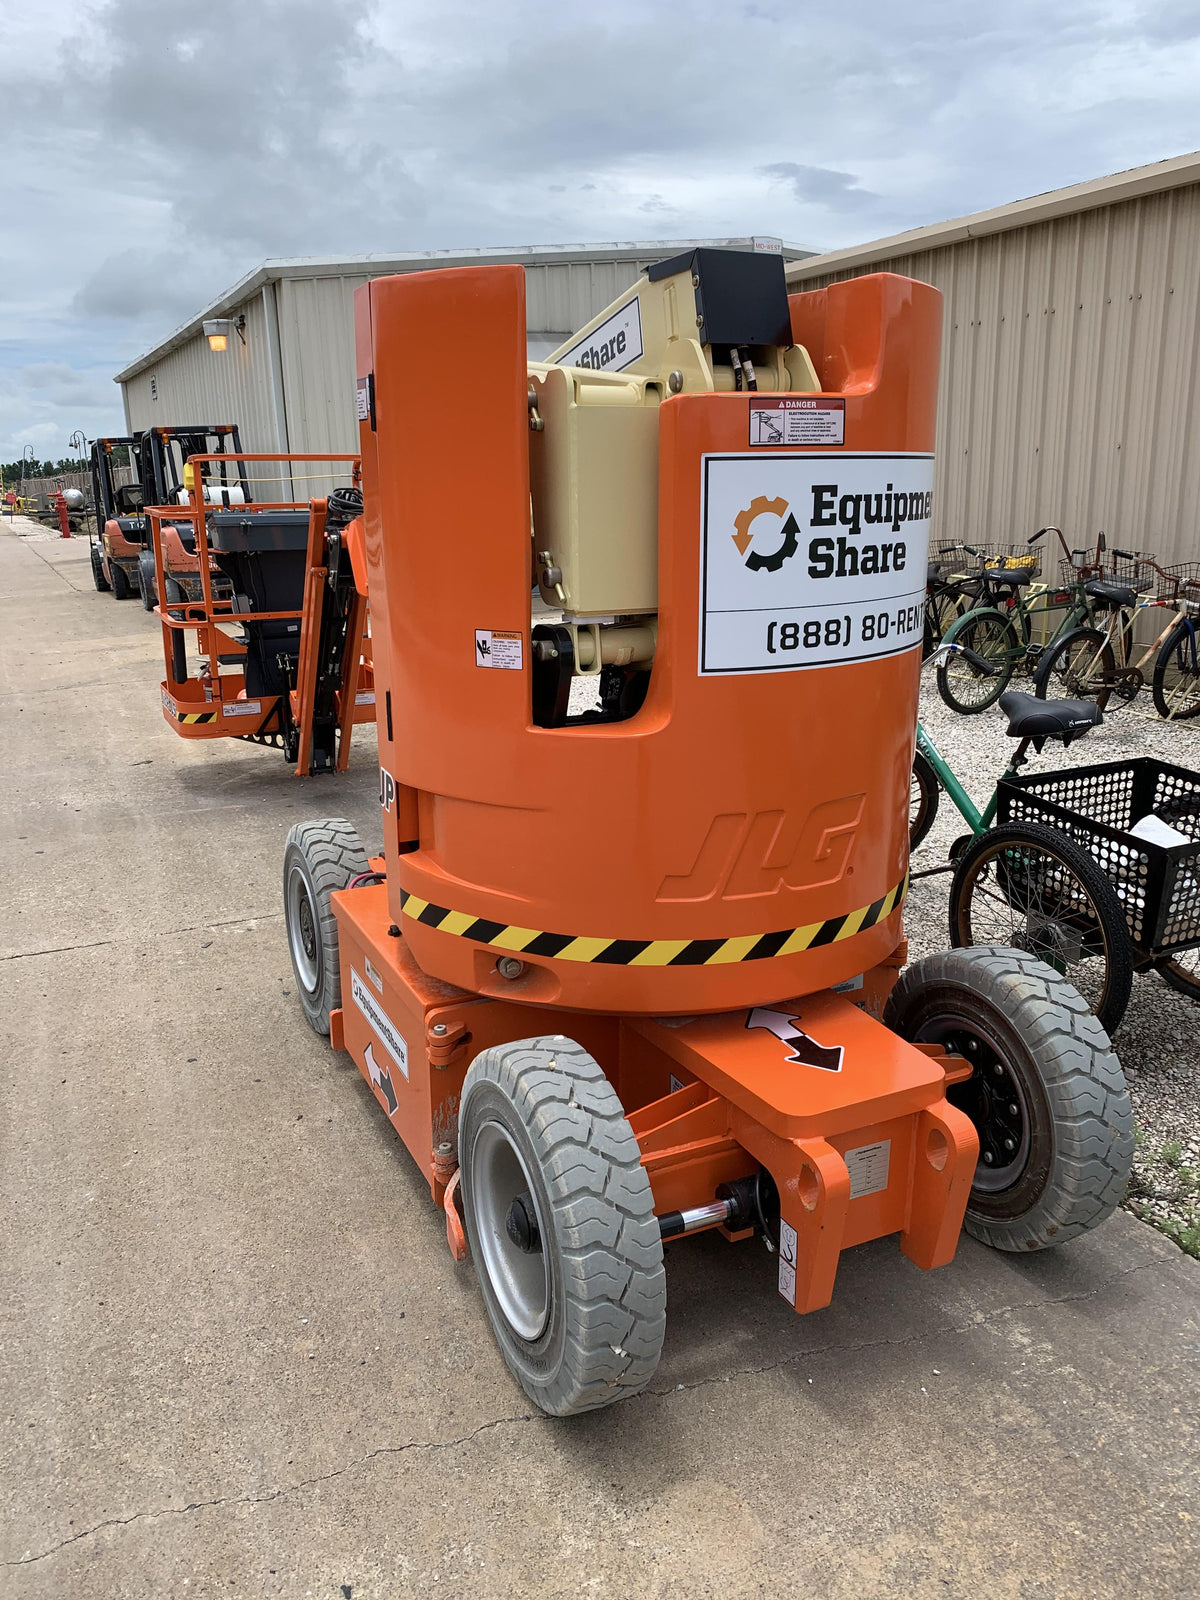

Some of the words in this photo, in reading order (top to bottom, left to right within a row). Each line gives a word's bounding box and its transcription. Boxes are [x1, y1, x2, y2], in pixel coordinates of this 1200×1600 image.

[785, 401, 817, 409] DANGER
[810, 483, 933, 535] Equipme
[807, 536, 906, 579] Share
[767, 615, 851, 654] (888)
[655, 792, 867, 903] JLG
